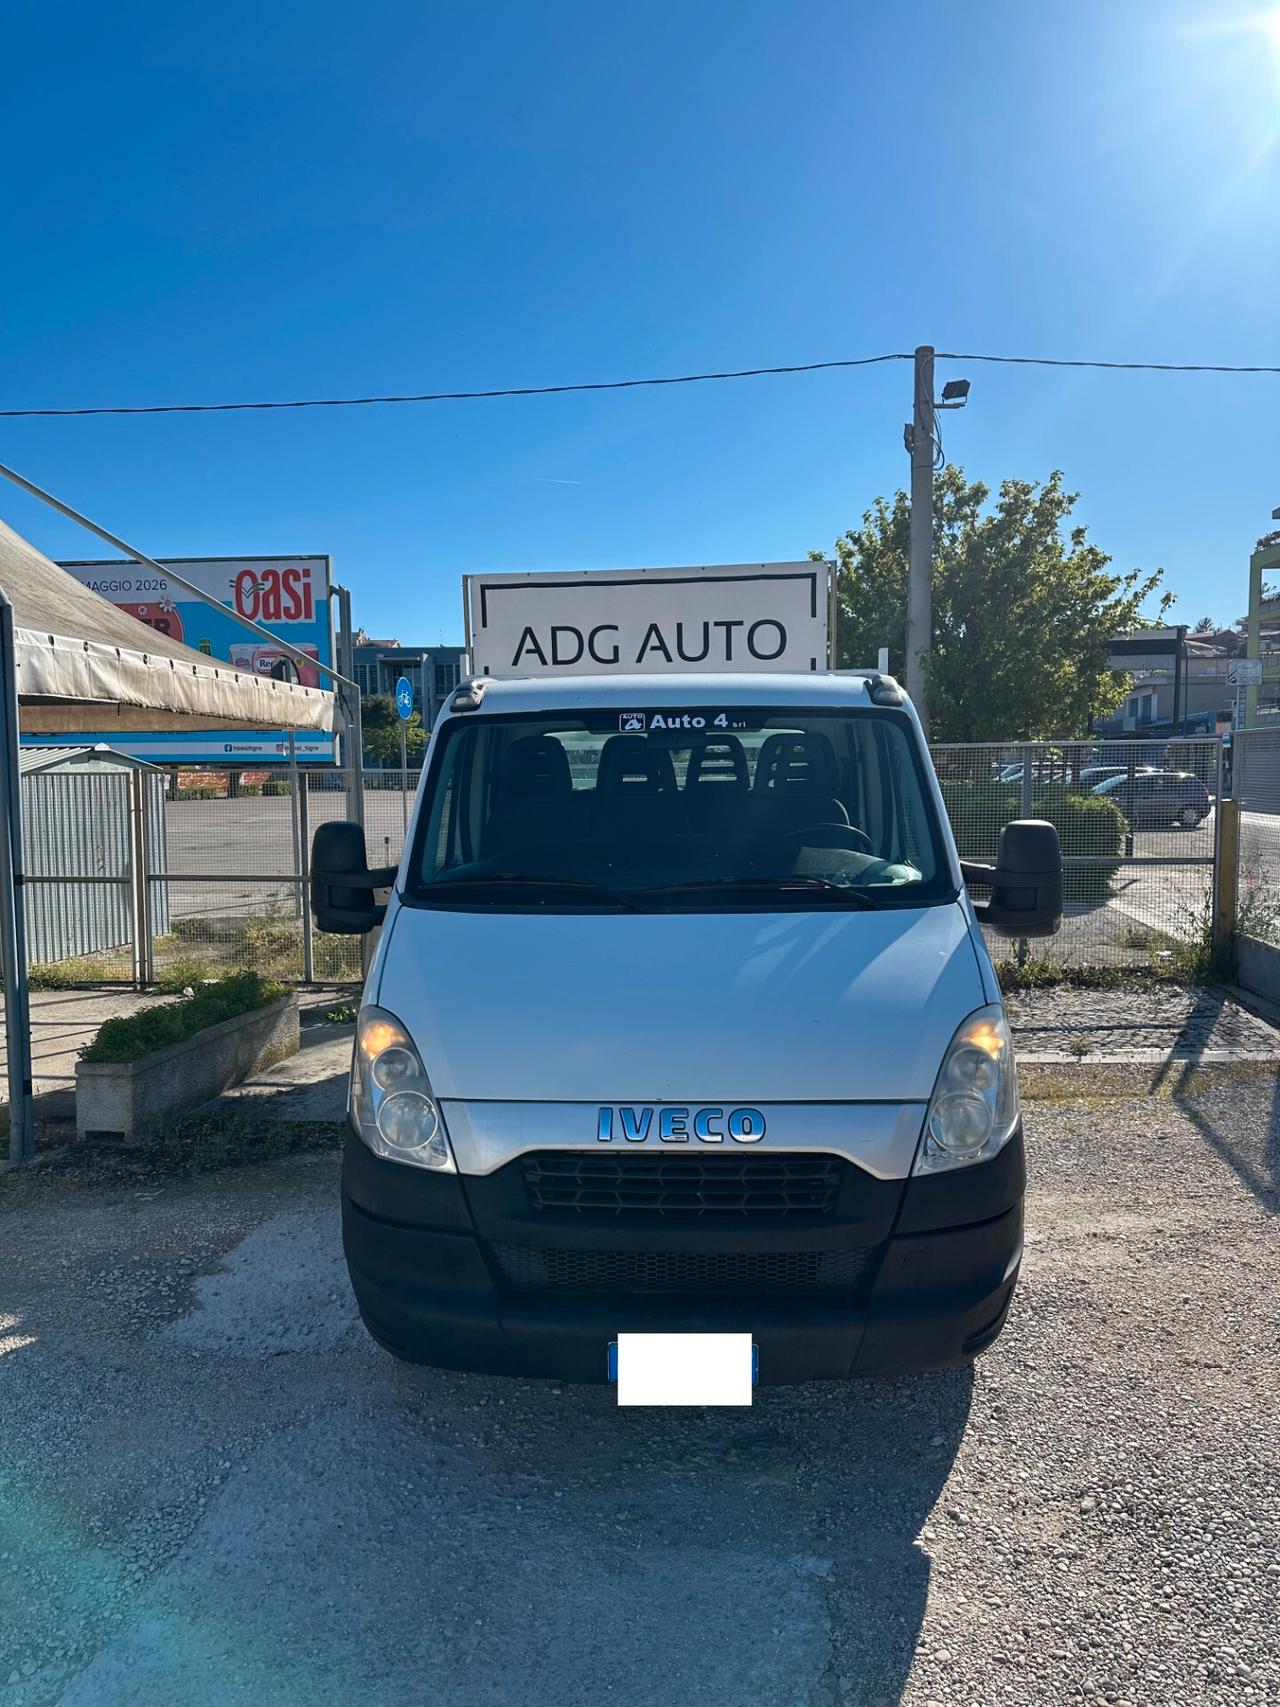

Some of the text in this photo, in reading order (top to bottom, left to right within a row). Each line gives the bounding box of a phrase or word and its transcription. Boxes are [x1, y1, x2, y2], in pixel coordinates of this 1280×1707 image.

[136, 579, 168, 591] 2026
[234, 568, 313, 621] Oasi
[511, 618, 788, 667] ADG AUTO
[649, 713, 706, 729] Auto
[712, 713, 729, 728] 4
[597, 1106, 767, 1144] IVECO
